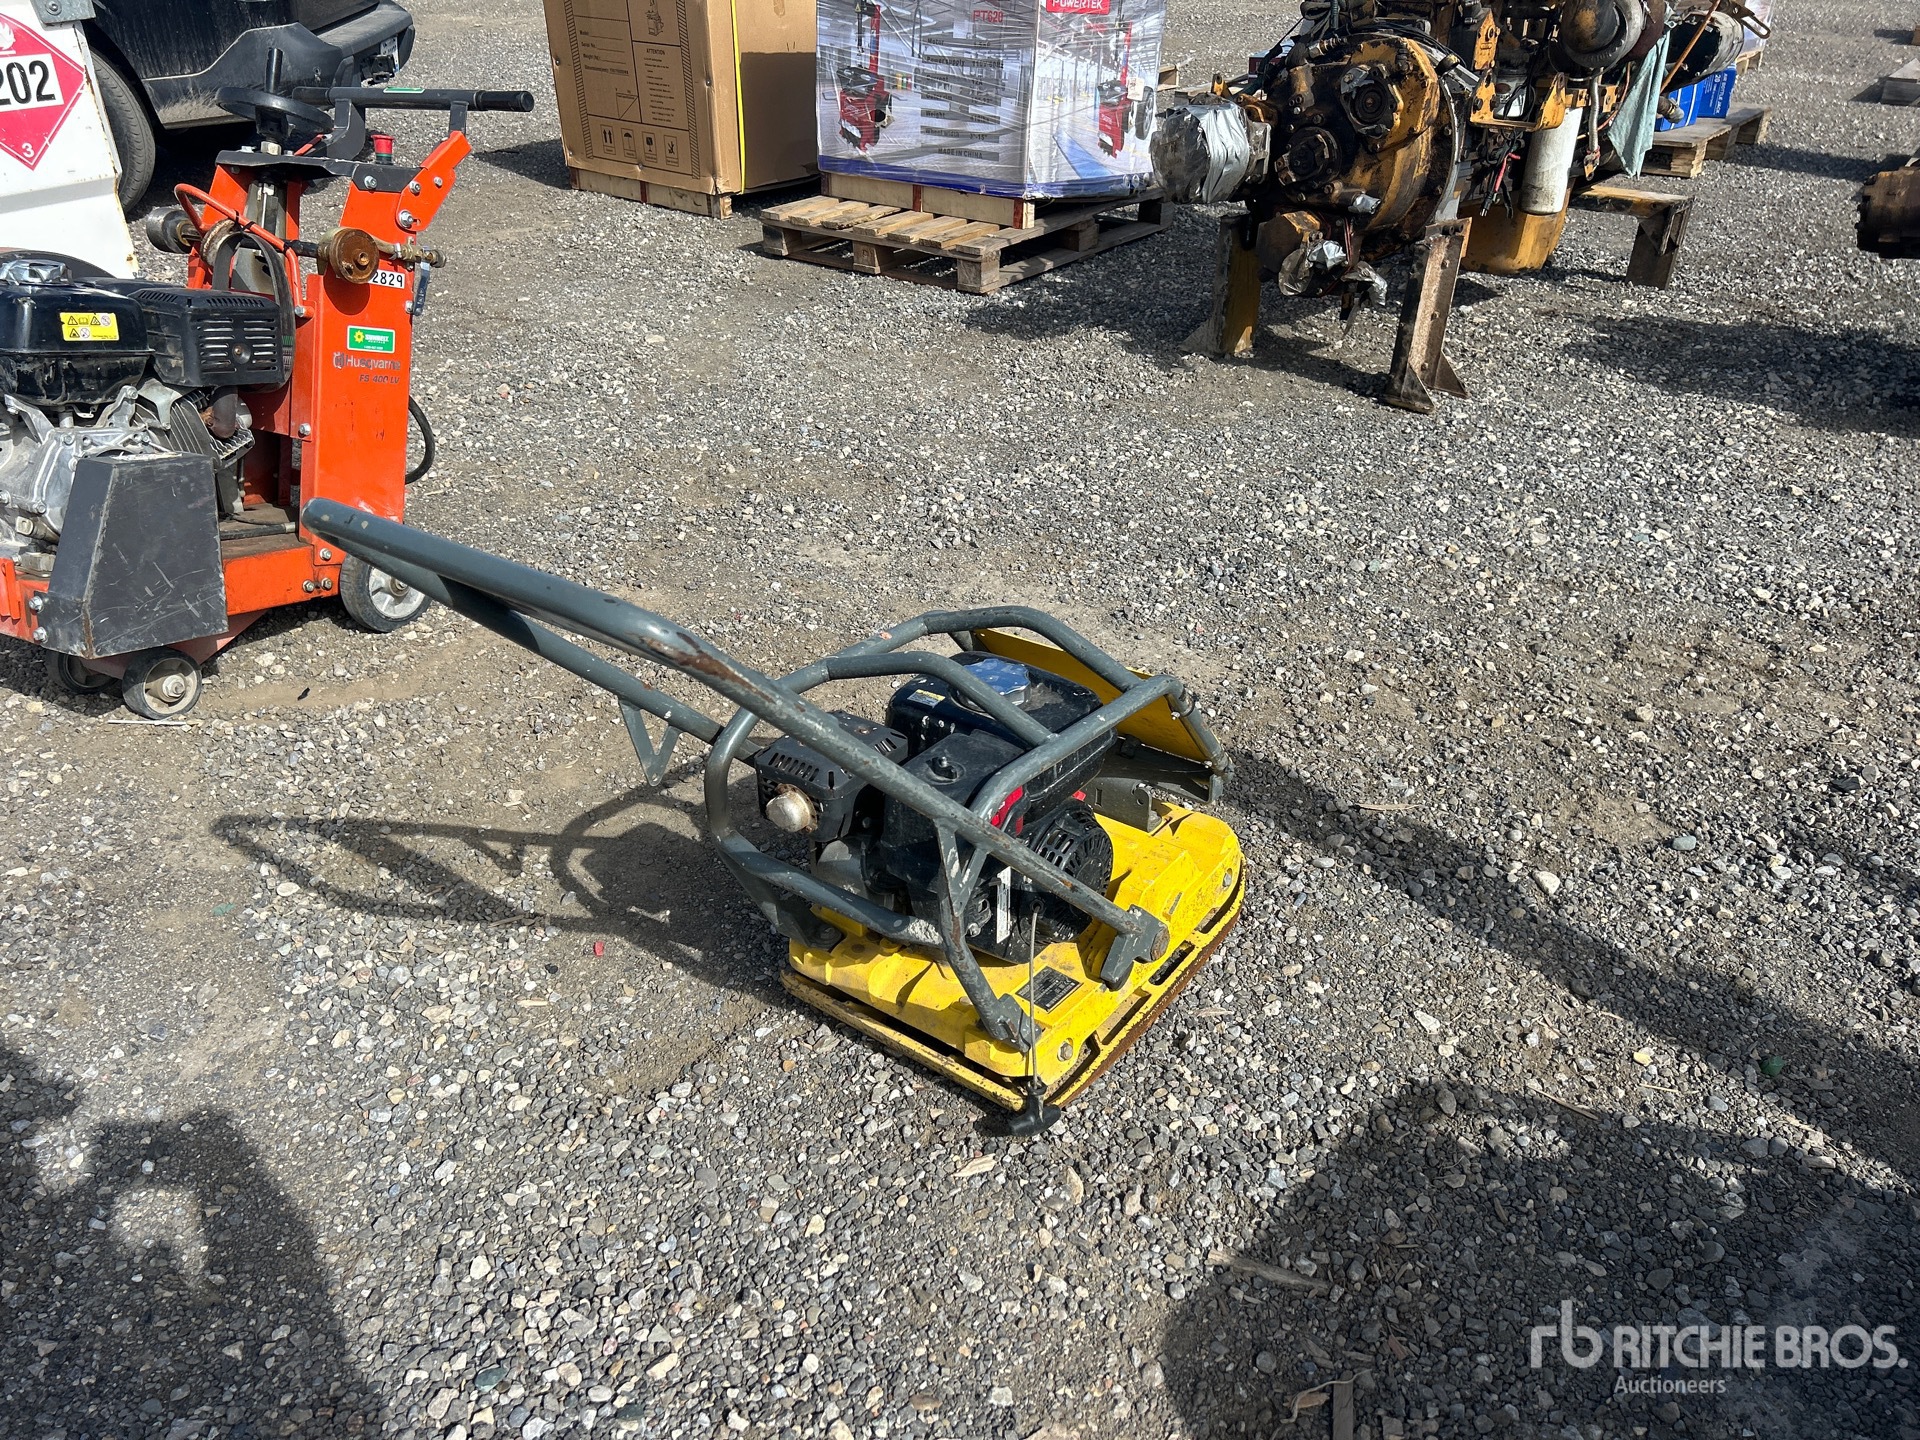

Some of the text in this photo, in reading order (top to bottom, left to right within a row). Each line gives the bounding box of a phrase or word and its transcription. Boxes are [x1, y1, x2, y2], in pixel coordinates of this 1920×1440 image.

[1052, 0, 1103, 10] POWERTEK
[21, 142, 35, 158] 3
[938, 148, 955, 156] MADE
[964, 150, 983, 159] CHINA
[372, 272, 403, 287] 2829
[345, 355, 401, 370] Husqvarna
